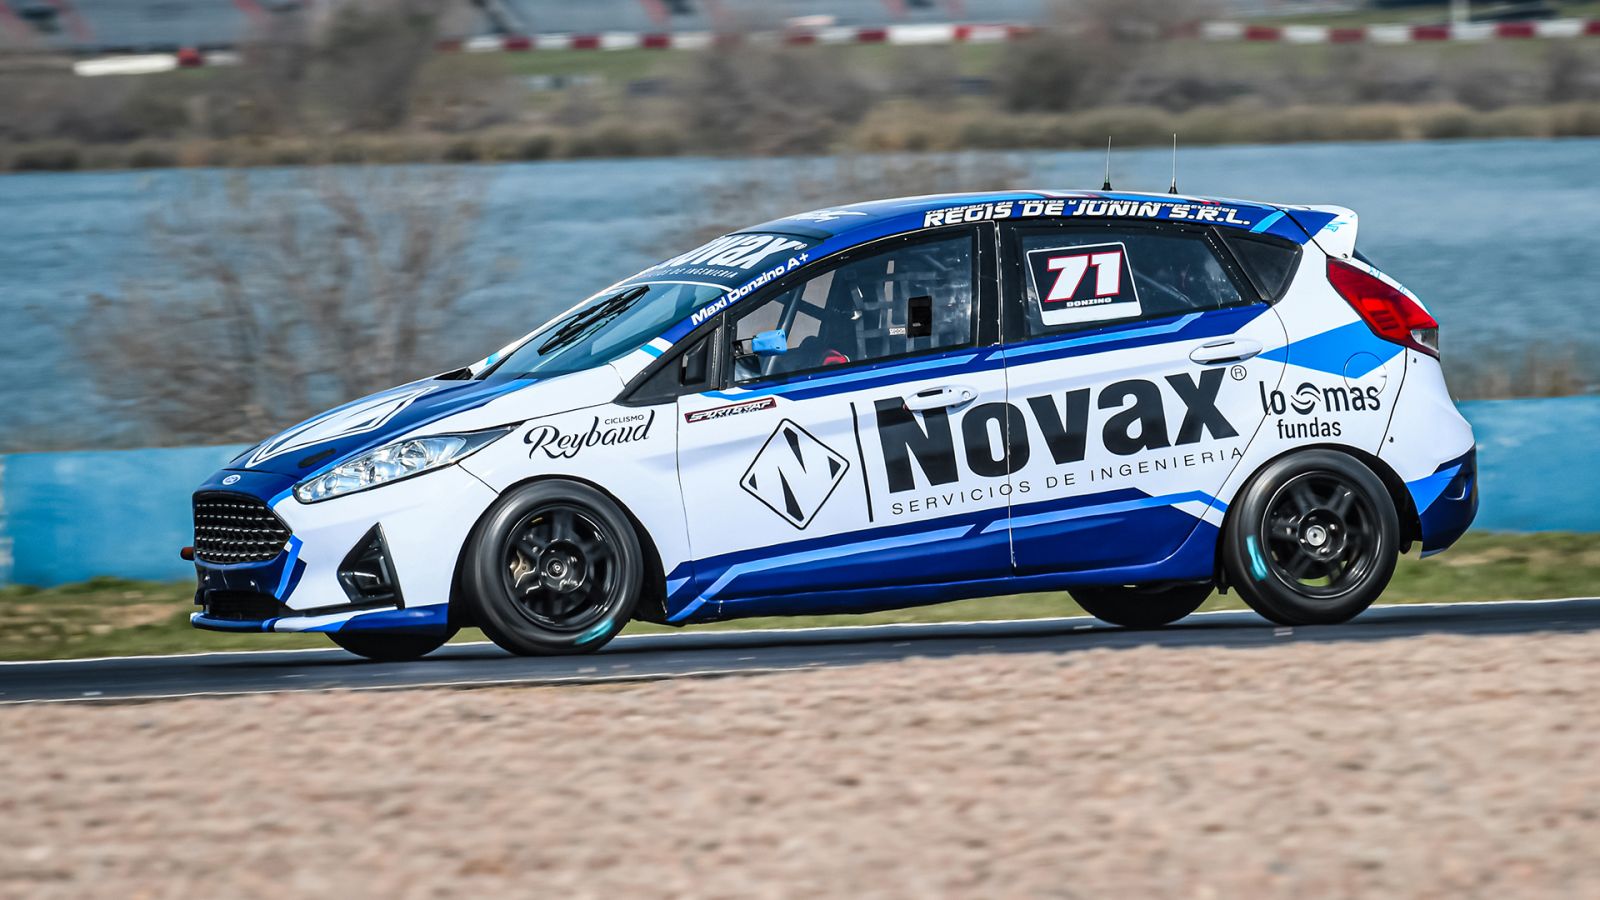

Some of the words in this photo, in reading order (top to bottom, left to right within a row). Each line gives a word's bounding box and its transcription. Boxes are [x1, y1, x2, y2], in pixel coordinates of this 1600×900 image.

[923, 205, 1012, 228] REGIS
[1021, 203, 1056, 217] DE
[1169, 205, 1250, 226] S.R.L.
[691, 298, 727, 326] Maxi
[728, 265, 785, 304] Donzino
[786, 252, 809, 271] A+
[1045, 250, 1123, 303] 71
[1066, 297, 1112, 307] DONZINO
[523, 409, 655, 460] Reybaud
[604, 414, 645, 425] CICLISMO
[1276, 416, 1342, 439] fundas
[892, 480, 1031, 516] SERVICIOS
[1046, 472, 1076, 489] DE
[1090, 447, 1243, 482] INGENIERIA
